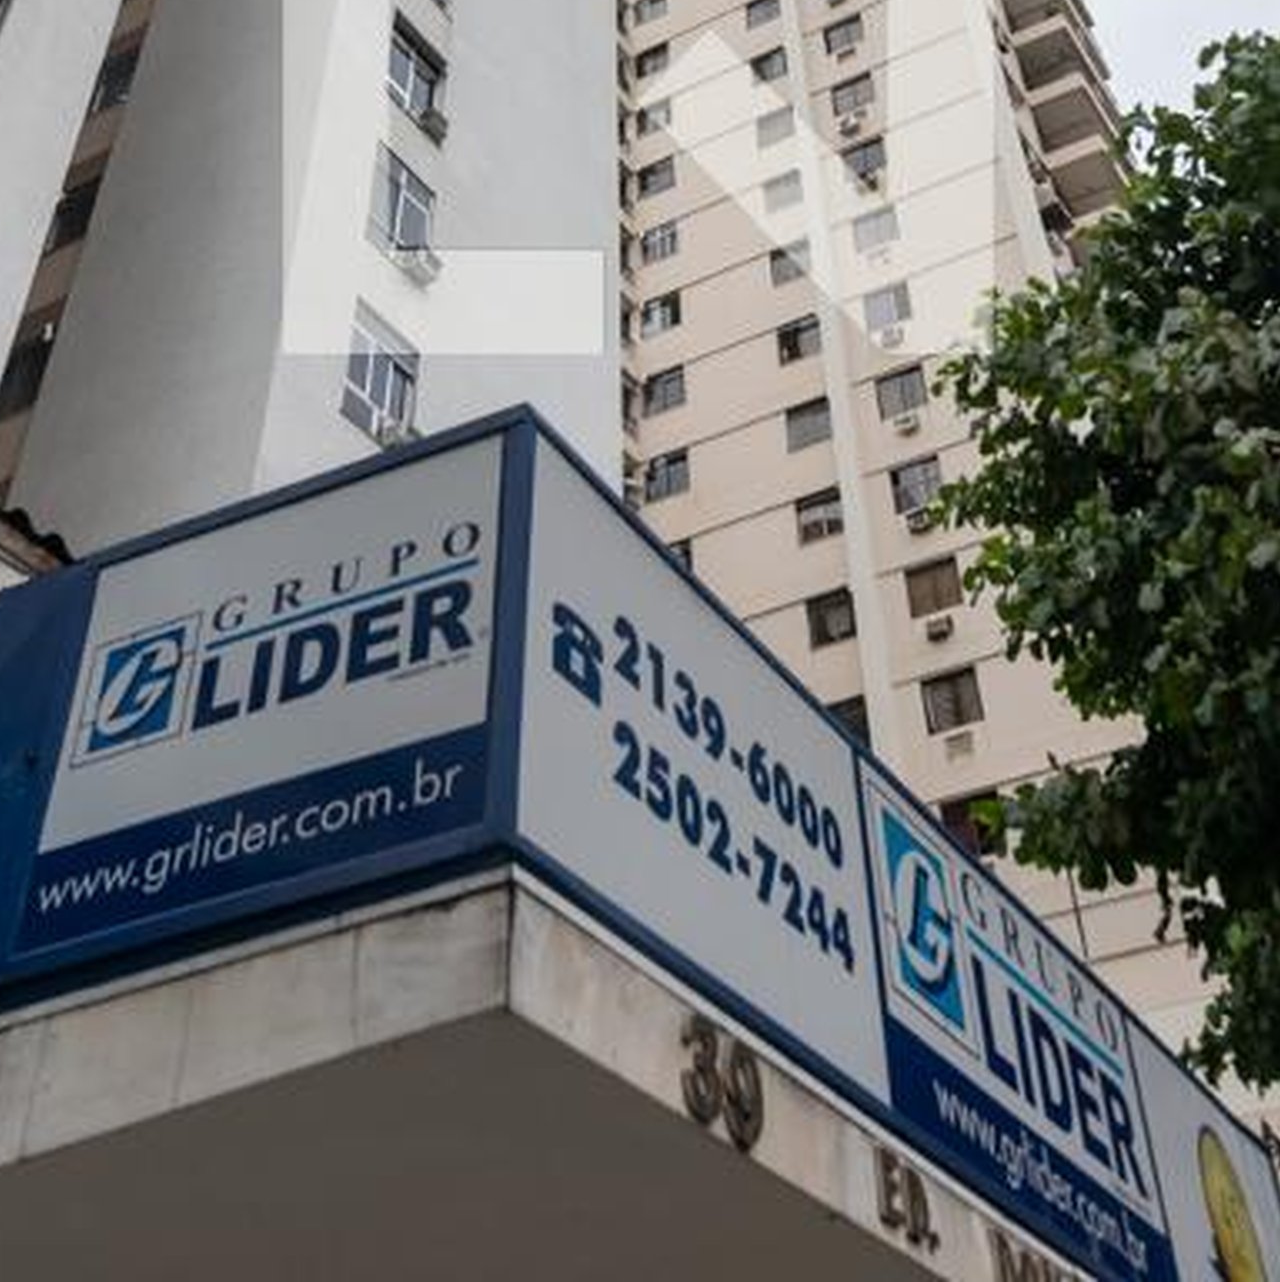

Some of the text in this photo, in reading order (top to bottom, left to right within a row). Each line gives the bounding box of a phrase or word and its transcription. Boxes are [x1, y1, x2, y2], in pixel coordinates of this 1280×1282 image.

[190, 579, 475, 731] LIDER
[211, 521, 482, 632] GRUPO
[613, 615, 843, 869] 2139-6000
[37, 756, 465, 915] www.grlider.com.br
[612, 720, 855, 974] 2502-7244
[960, 871, 1118, 1052] GRUPO
[970, 951, 1151, 1201] LIDER
